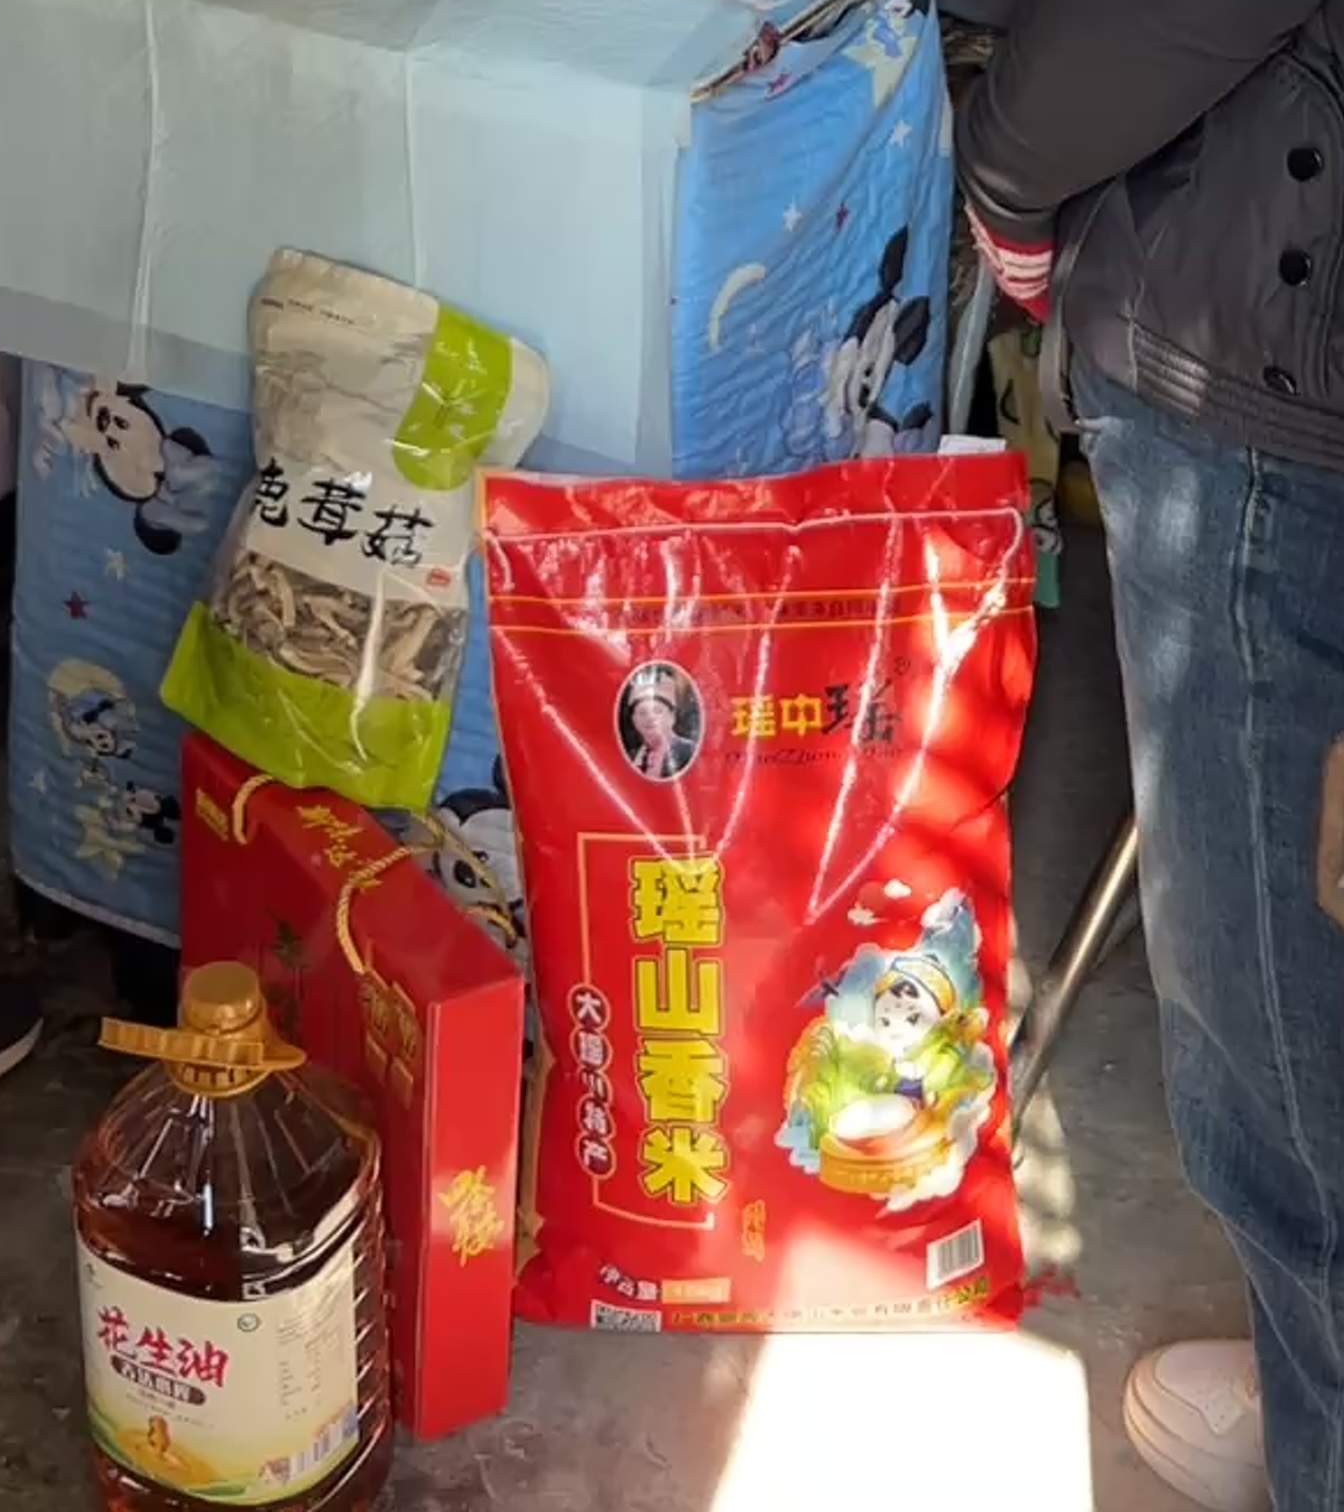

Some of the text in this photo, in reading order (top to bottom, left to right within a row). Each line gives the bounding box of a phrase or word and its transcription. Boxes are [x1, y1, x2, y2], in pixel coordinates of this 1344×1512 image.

[632, 855, 729, 1205] 瑶山香米
[97, 1305, 229, 1388] 花生油
